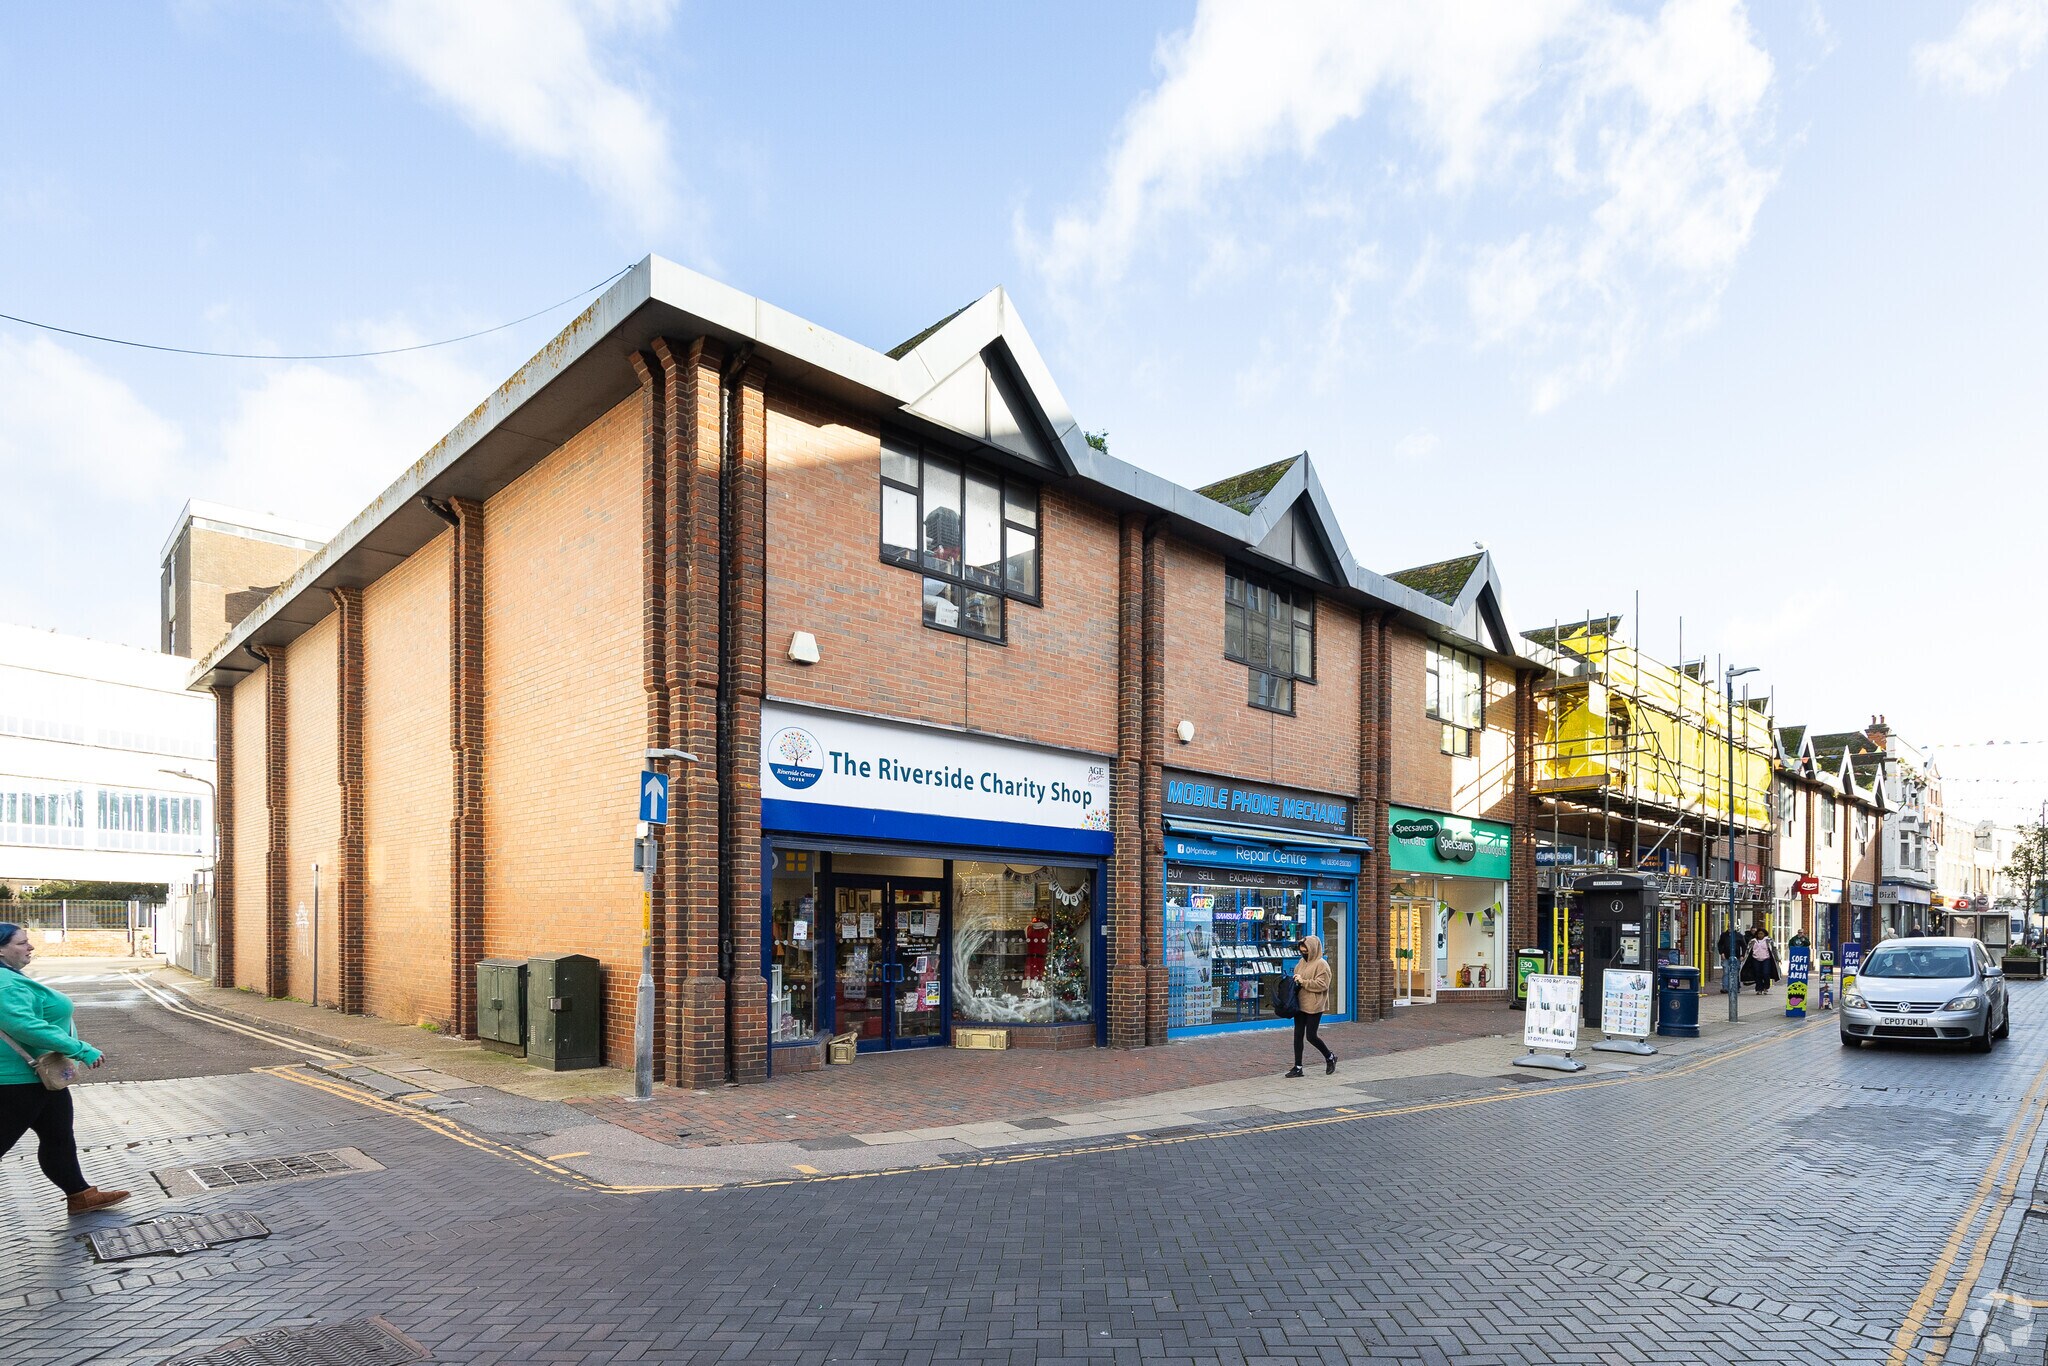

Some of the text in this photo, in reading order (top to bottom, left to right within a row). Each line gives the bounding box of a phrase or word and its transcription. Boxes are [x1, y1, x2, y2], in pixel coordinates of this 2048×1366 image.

[777, 768, 816, 779] Riverside Centre
[1088, 766, 1104, 775] AGE
[829, 751, 1092, 809] The Riverside Charity Shop
[1167, 780, 1347, 826] MOBILE PHONE MECHANIC
[1395, 823, 1434, 834] Specsavers
[1440, 836, 1474, 852] Specsavers
[1236, 845, 1307, 865] Repair Centre
[1167, 868, 1299, 885] BUY SELL EXCHANGE REPAIR
[1742, 866, 1757, 883] Agos
[1879, 891, 1897, 899] BizR
[1192, 898, 1213, 908] VAPES
[1242, 909, 1264, 920] REPAIR
[1791, 955, 1808, 963] SOFT
[1822, 953, 1831, 961] VR
[1790, 963, 1808, 971] PLAY
[1789, 971, 1807, 979] AREA
[1884, 1017, 1924, 1026] CP07 OMJ
